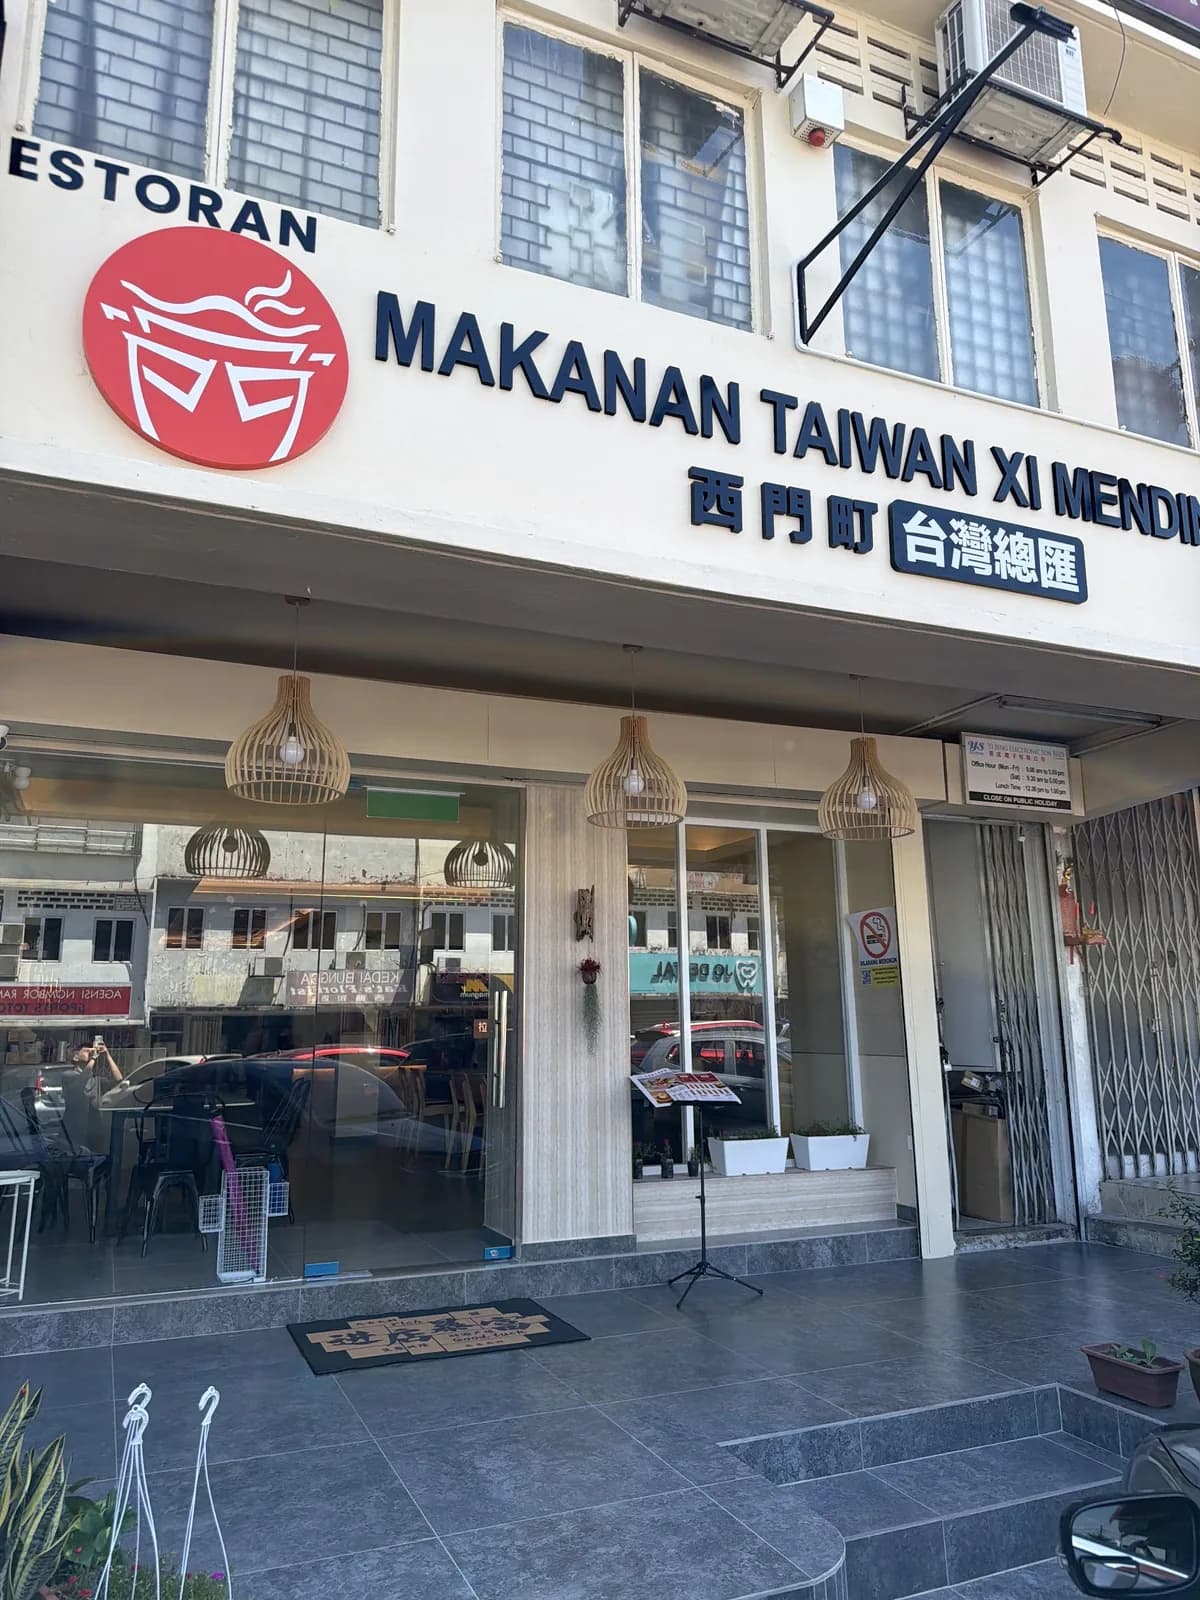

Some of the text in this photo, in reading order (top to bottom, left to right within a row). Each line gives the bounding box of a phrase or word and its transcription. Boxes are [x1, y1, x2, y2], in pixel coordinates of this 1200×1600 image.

[8, 136, 317, 254] ESTORAN
[374, 290, 741, 446] MAKANAN
[759, 388, 978, 497] TAIWAN
[989, 446, 1041, 511] XI
[688, 465, 879, 555] 西門町
[902, 509, 1080, 593] 台灣總匯
[984, 794, 1057, 807] CLOSE ON PUBLIC HOLIDAY
